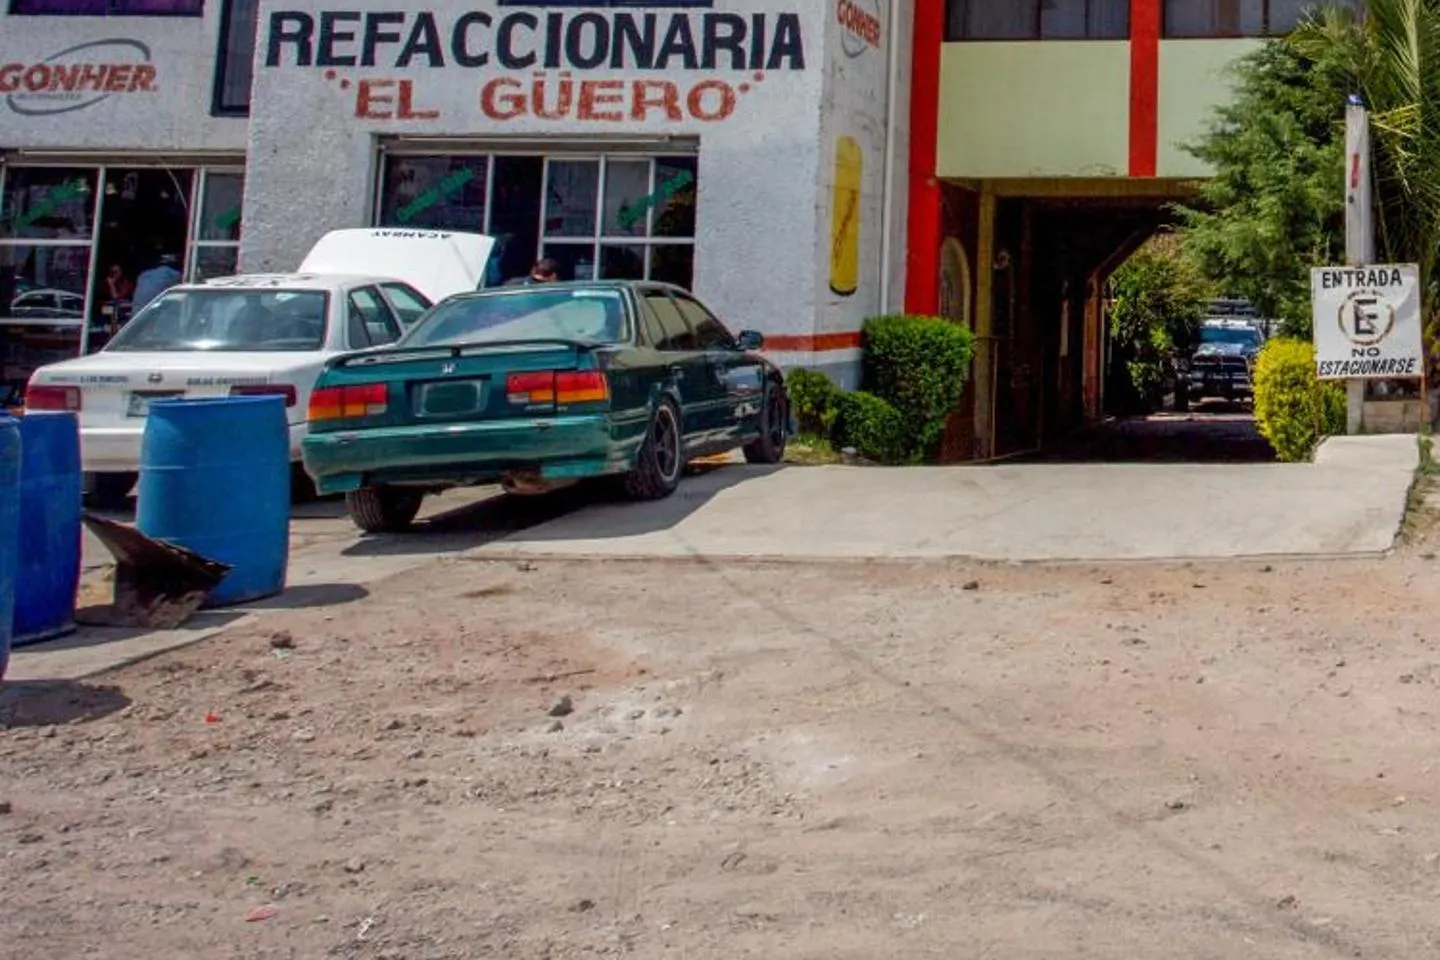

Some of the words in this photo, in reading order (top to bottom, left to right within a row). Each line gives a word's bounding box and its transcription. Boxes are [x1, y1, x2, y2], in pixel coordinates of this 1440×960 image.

[264, 10, 807, 72] REFACCIONARIA
[0, 62, 157, 93] GONHER
[1322, 268, 1403, 289] ENTRADA
[1351, 346, 1381, 358] NO
[1318, 358, 1416, 376] ESTACIONARSE
